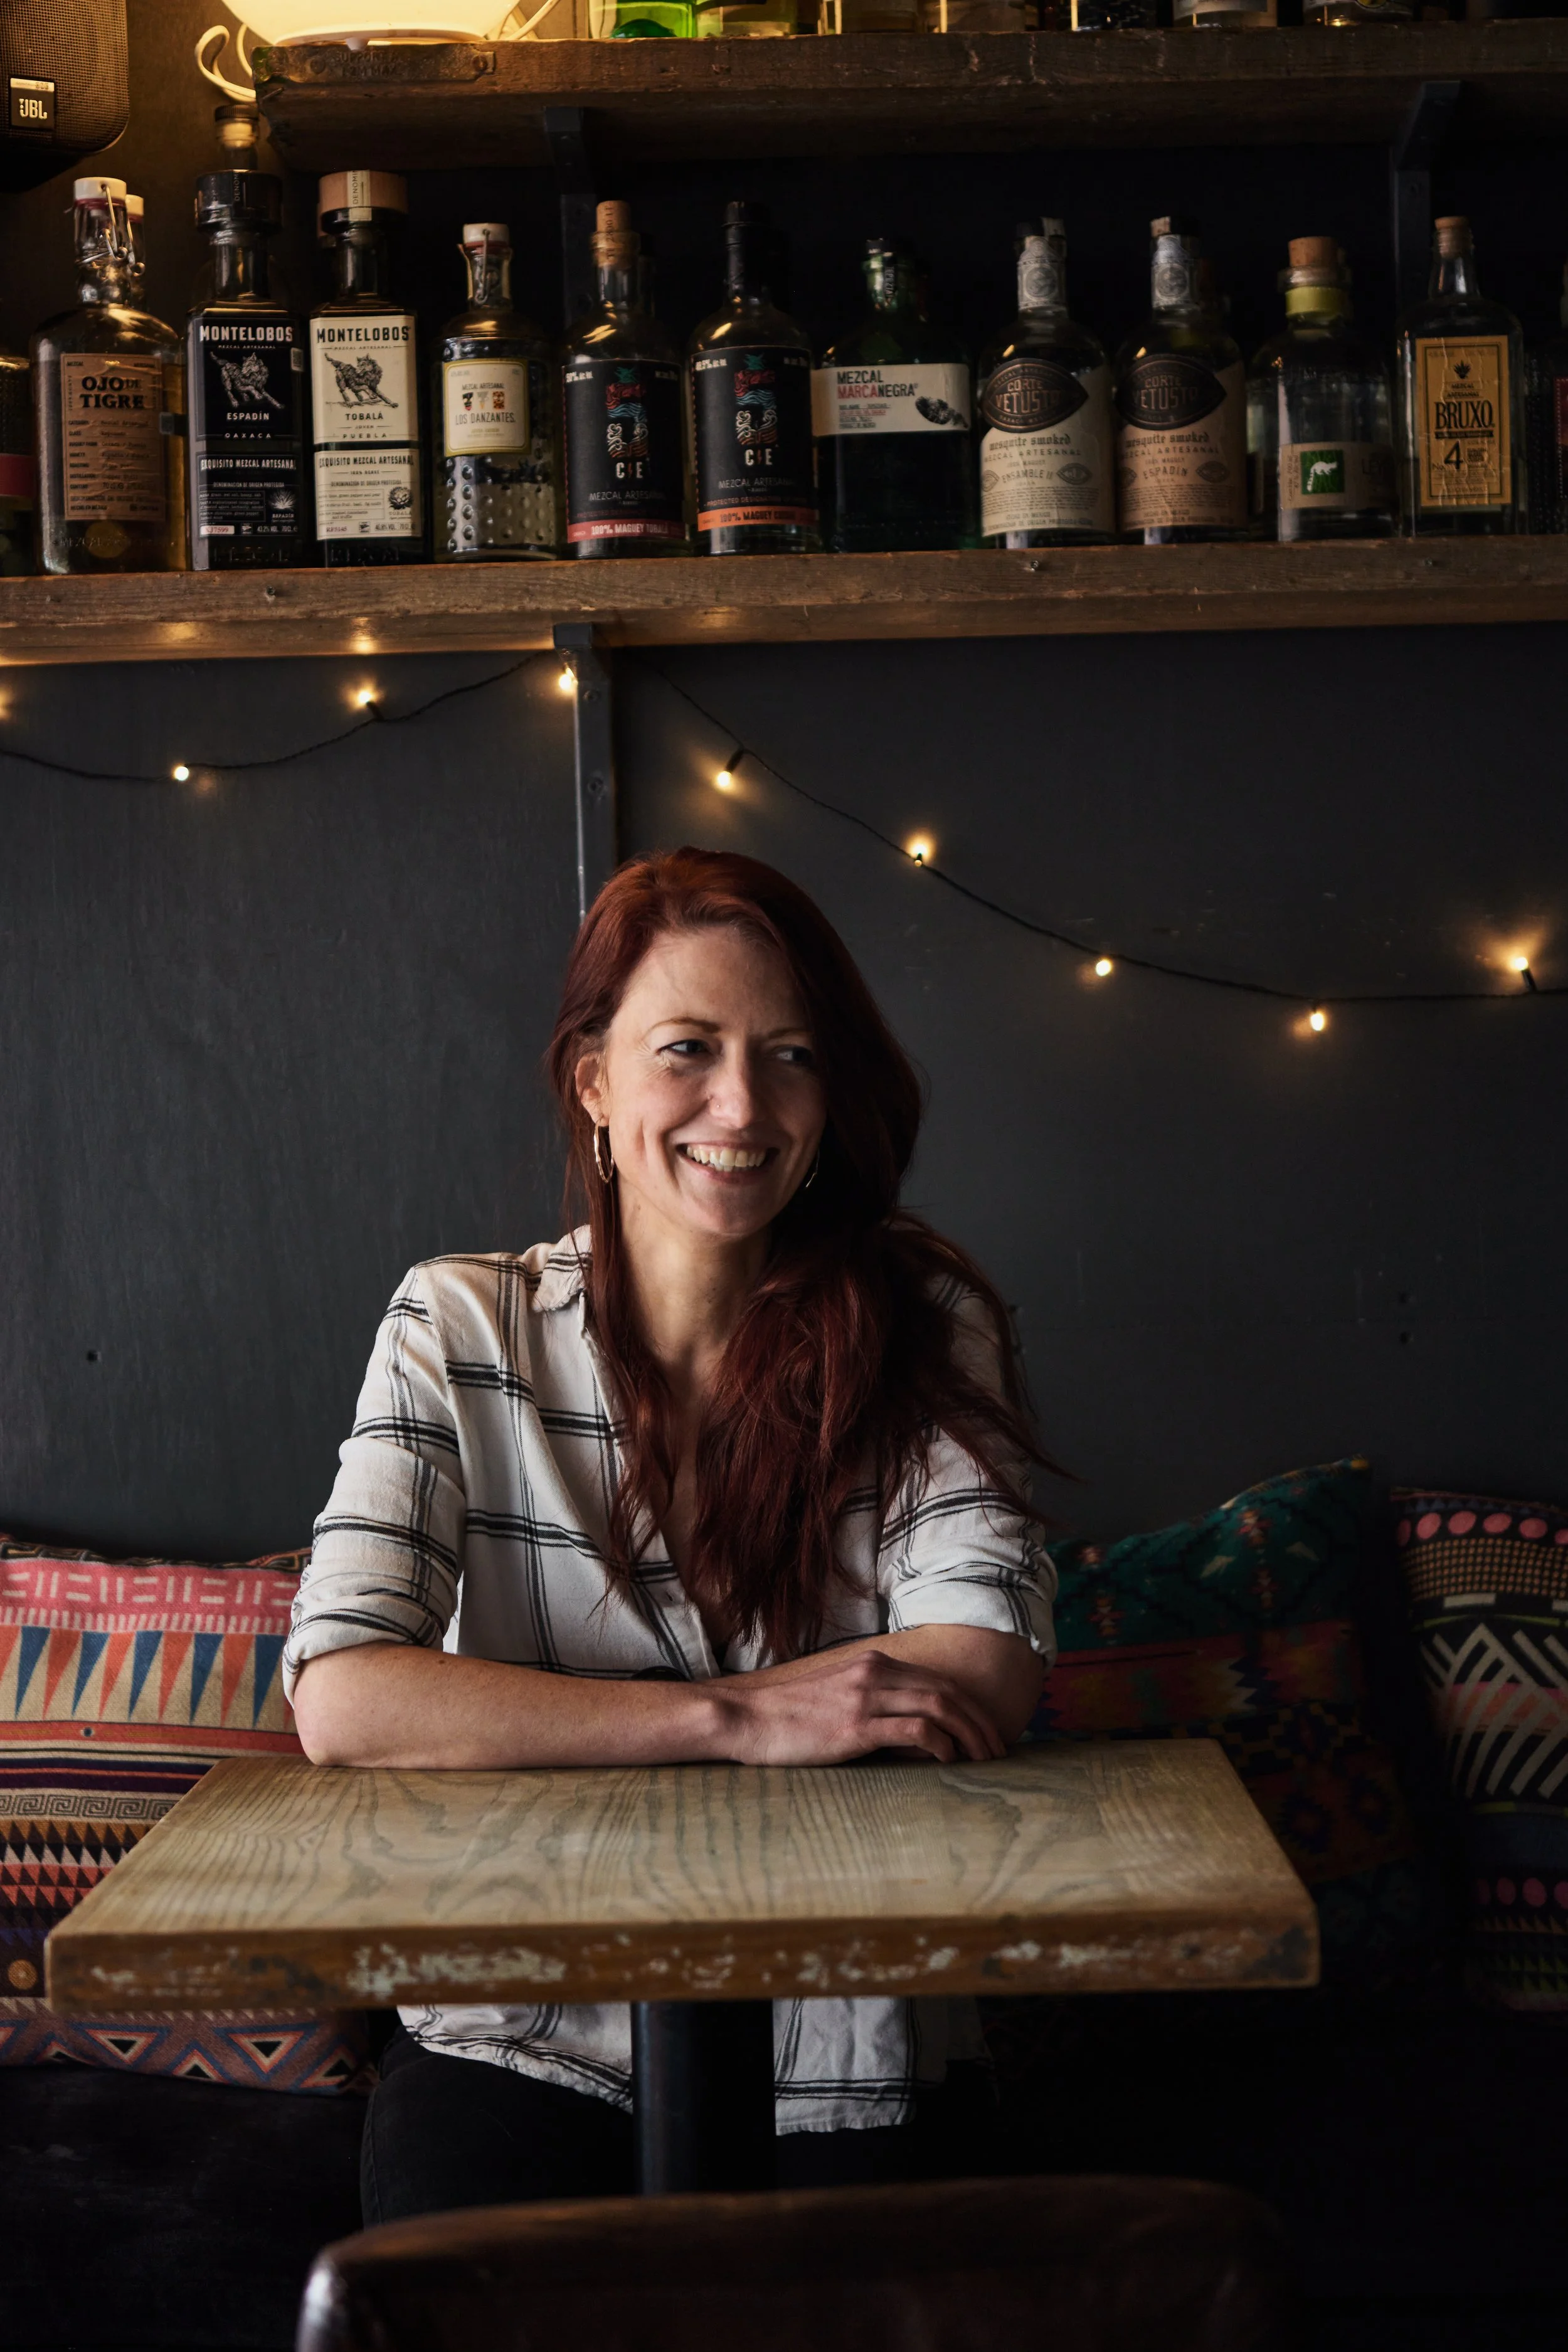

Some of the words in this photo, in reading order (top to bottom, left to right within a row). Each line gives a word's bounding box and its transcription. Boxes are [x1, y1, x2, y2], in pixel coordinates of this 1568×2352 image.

[19, 98, 48, 119] JBL
[199, 325, 294, 342] MONTELOBOS
[316, 326, 410, 343] MONTELOBOS
[836, 369, 884, 384] MEZCAL
[1144, 374, 1184, 388] CORTE
[81, 376, 124, 392] OJO
[125, 378, 142, 388] DE
[462, 383, 479, 391] MEZCAL
[1007, 378, 1043, 392] CORTE
[79, 393, 146, 409] TIGRE
[226, 411, 270, 421] ESPADÍN
[345, 411, 384, 421] TOBALÁ
[455, 413, 468, 425] LOS
[1434, 400, 1493, 430] BRUXO
[1019, 448, 1081, 457] ARTESANAL
[1121, 448, 1151, 460] EZCAL
[1157, 446, 1219, 454] ARTESANAL
[1444, 440, 1465, 470] 4
[200, 459, 234, 471] EXQUISITO
[235, 458, 260, 469] MEZCAL
[319, 457, 351, 469] EXQUISITO
[352, 456, 378, 465] MEZCAL
[378, 454, 415, 465] ARTESANAL
[1002, 469, 1044, 484] ENSAMBLE
[718, 479, 751, 489] MEZCAL
[588, 491, 622, 501] MEZCAL
[590, 524, 614, 535] 100%
[614, 522, 645, 534] MAGUEY
